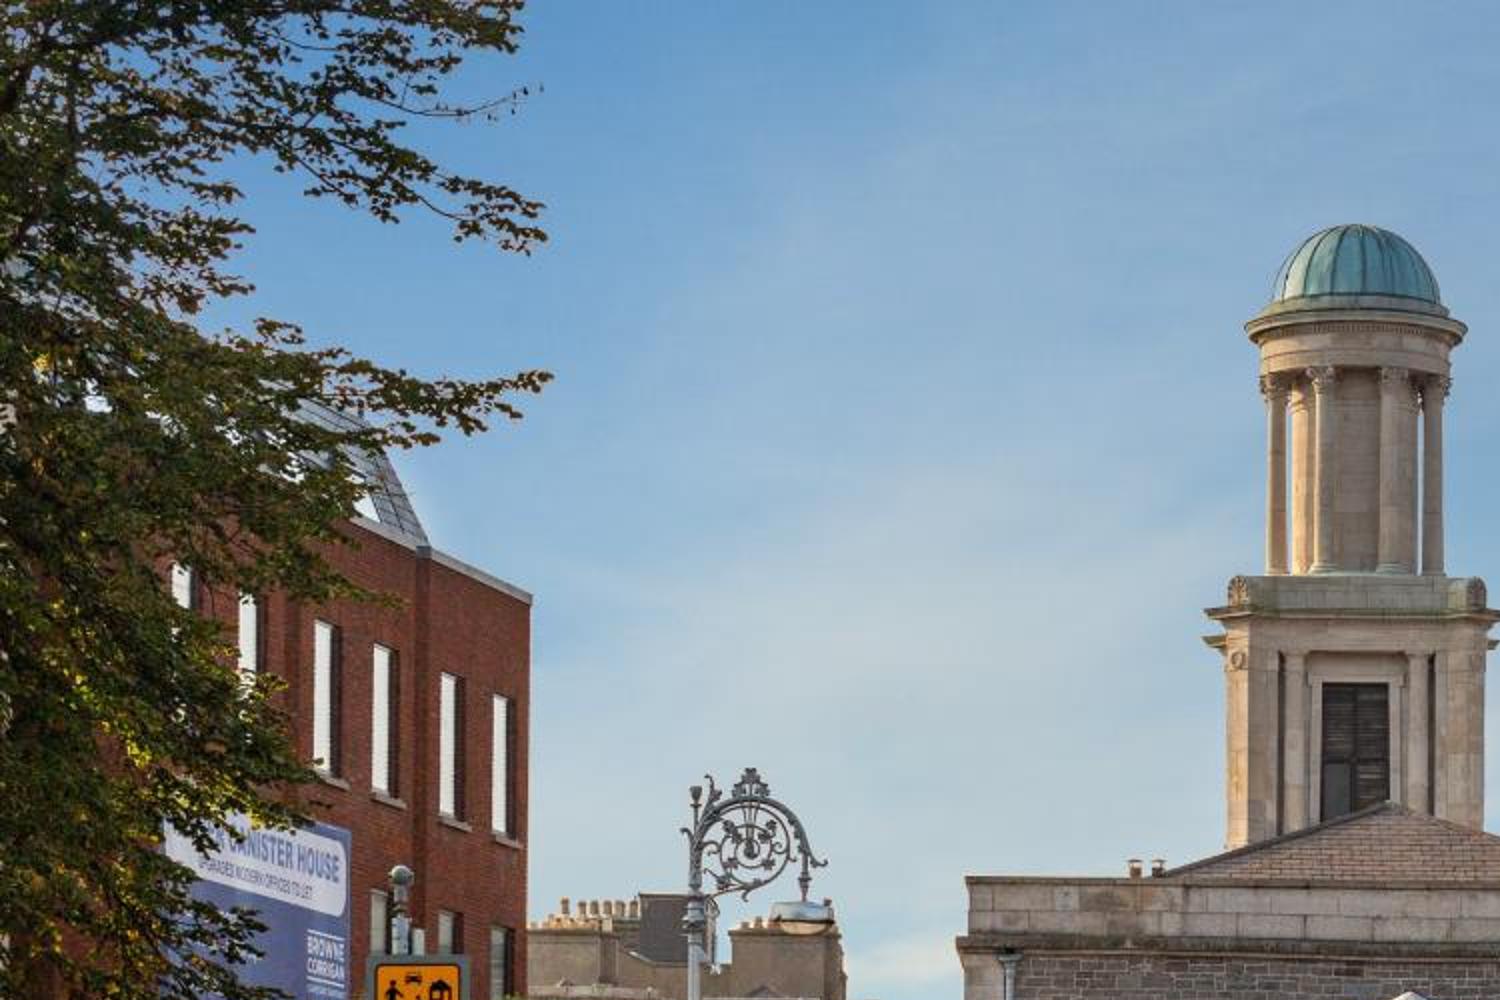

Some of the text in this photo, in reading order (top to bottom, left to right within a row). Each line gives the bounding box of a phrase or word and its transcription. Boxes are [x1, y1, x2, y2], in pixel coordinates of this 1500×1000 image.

[297, 844, 341, 883] HOUSE
[307, 935, 345, 962] BROWNE
[307, 957, 345, 980] CORRIGAN
